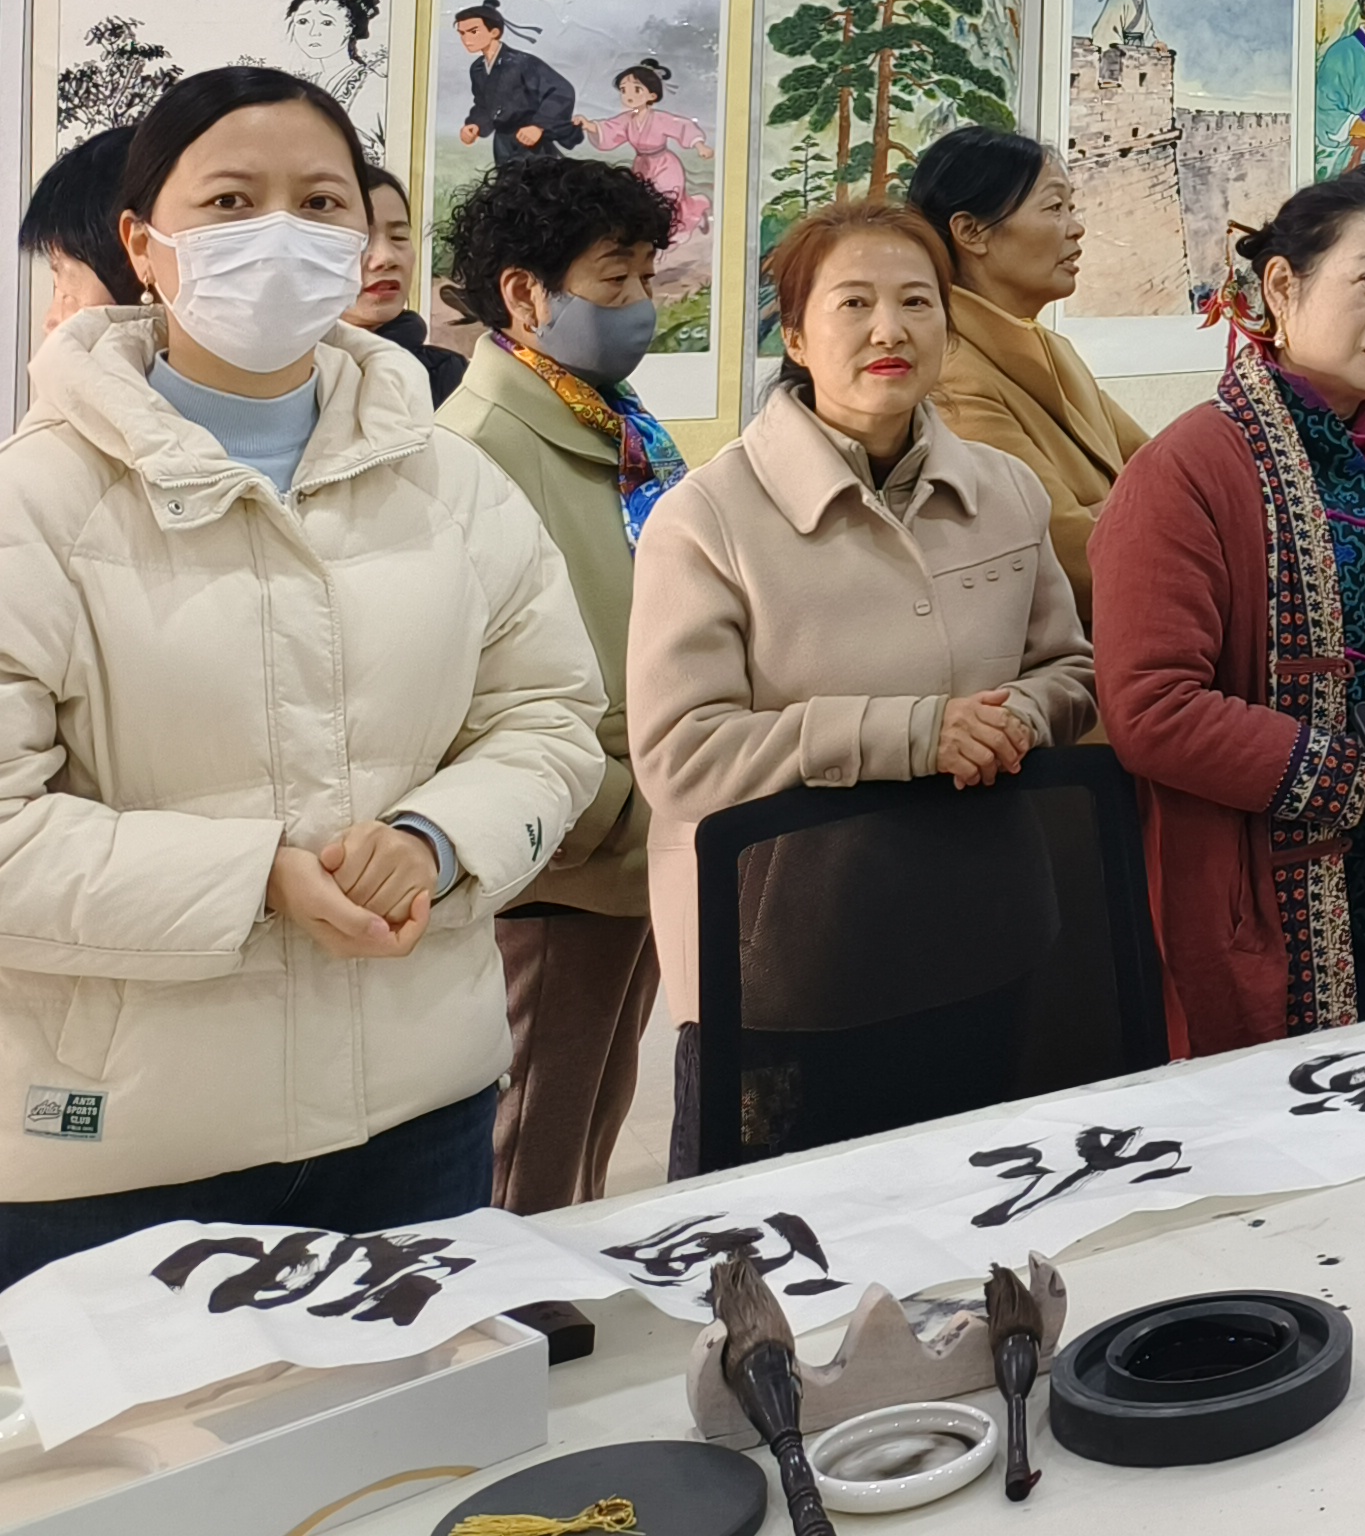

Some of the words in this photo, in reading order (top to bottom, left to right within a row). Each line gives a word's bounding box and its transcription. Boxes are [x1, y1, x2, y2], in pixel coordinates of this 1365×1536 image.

[72, 1096, 96, 1106] ANTA
[66, 1105, 98, 1116] SPORTS
[70, 1116, 91, 1125] CLUB
